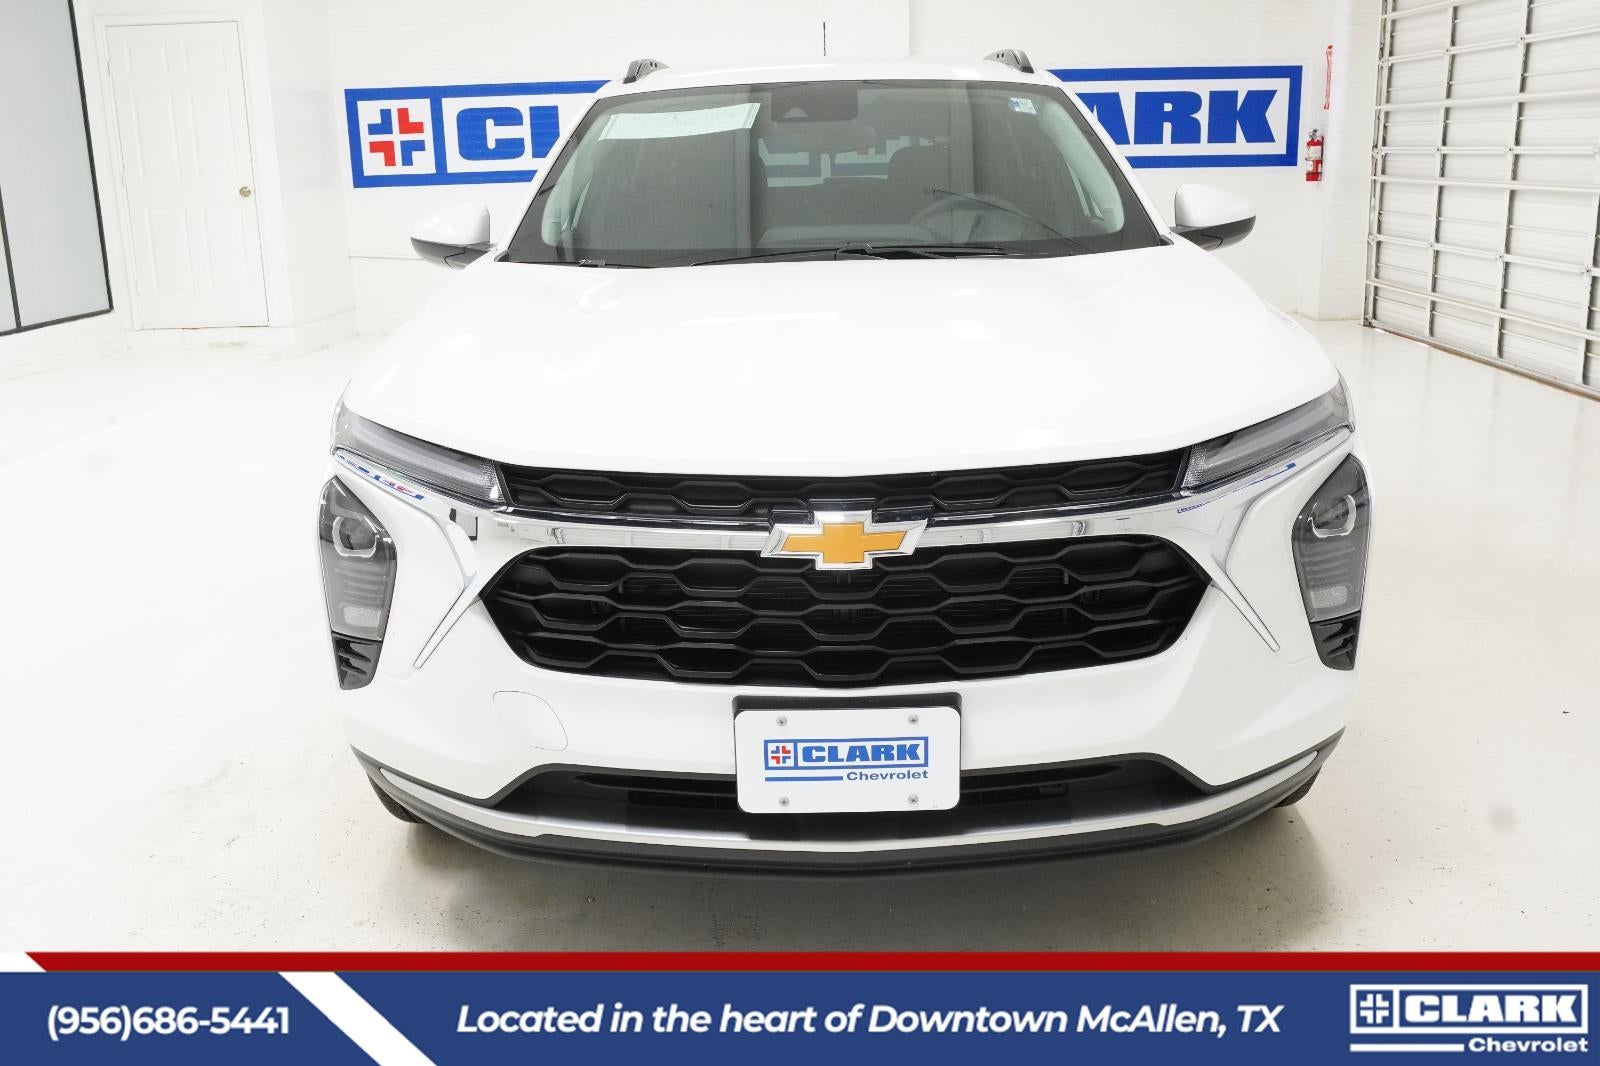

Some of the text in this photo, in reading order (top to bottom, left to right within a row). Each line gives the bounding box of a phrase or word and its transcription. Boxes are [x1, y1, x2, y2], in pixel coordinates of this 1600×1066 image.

[1075, 89, 1278, 145] ARK
[802, 743, 920, 763] CLARK
[846, 769, 929, 781] Chevrolet
